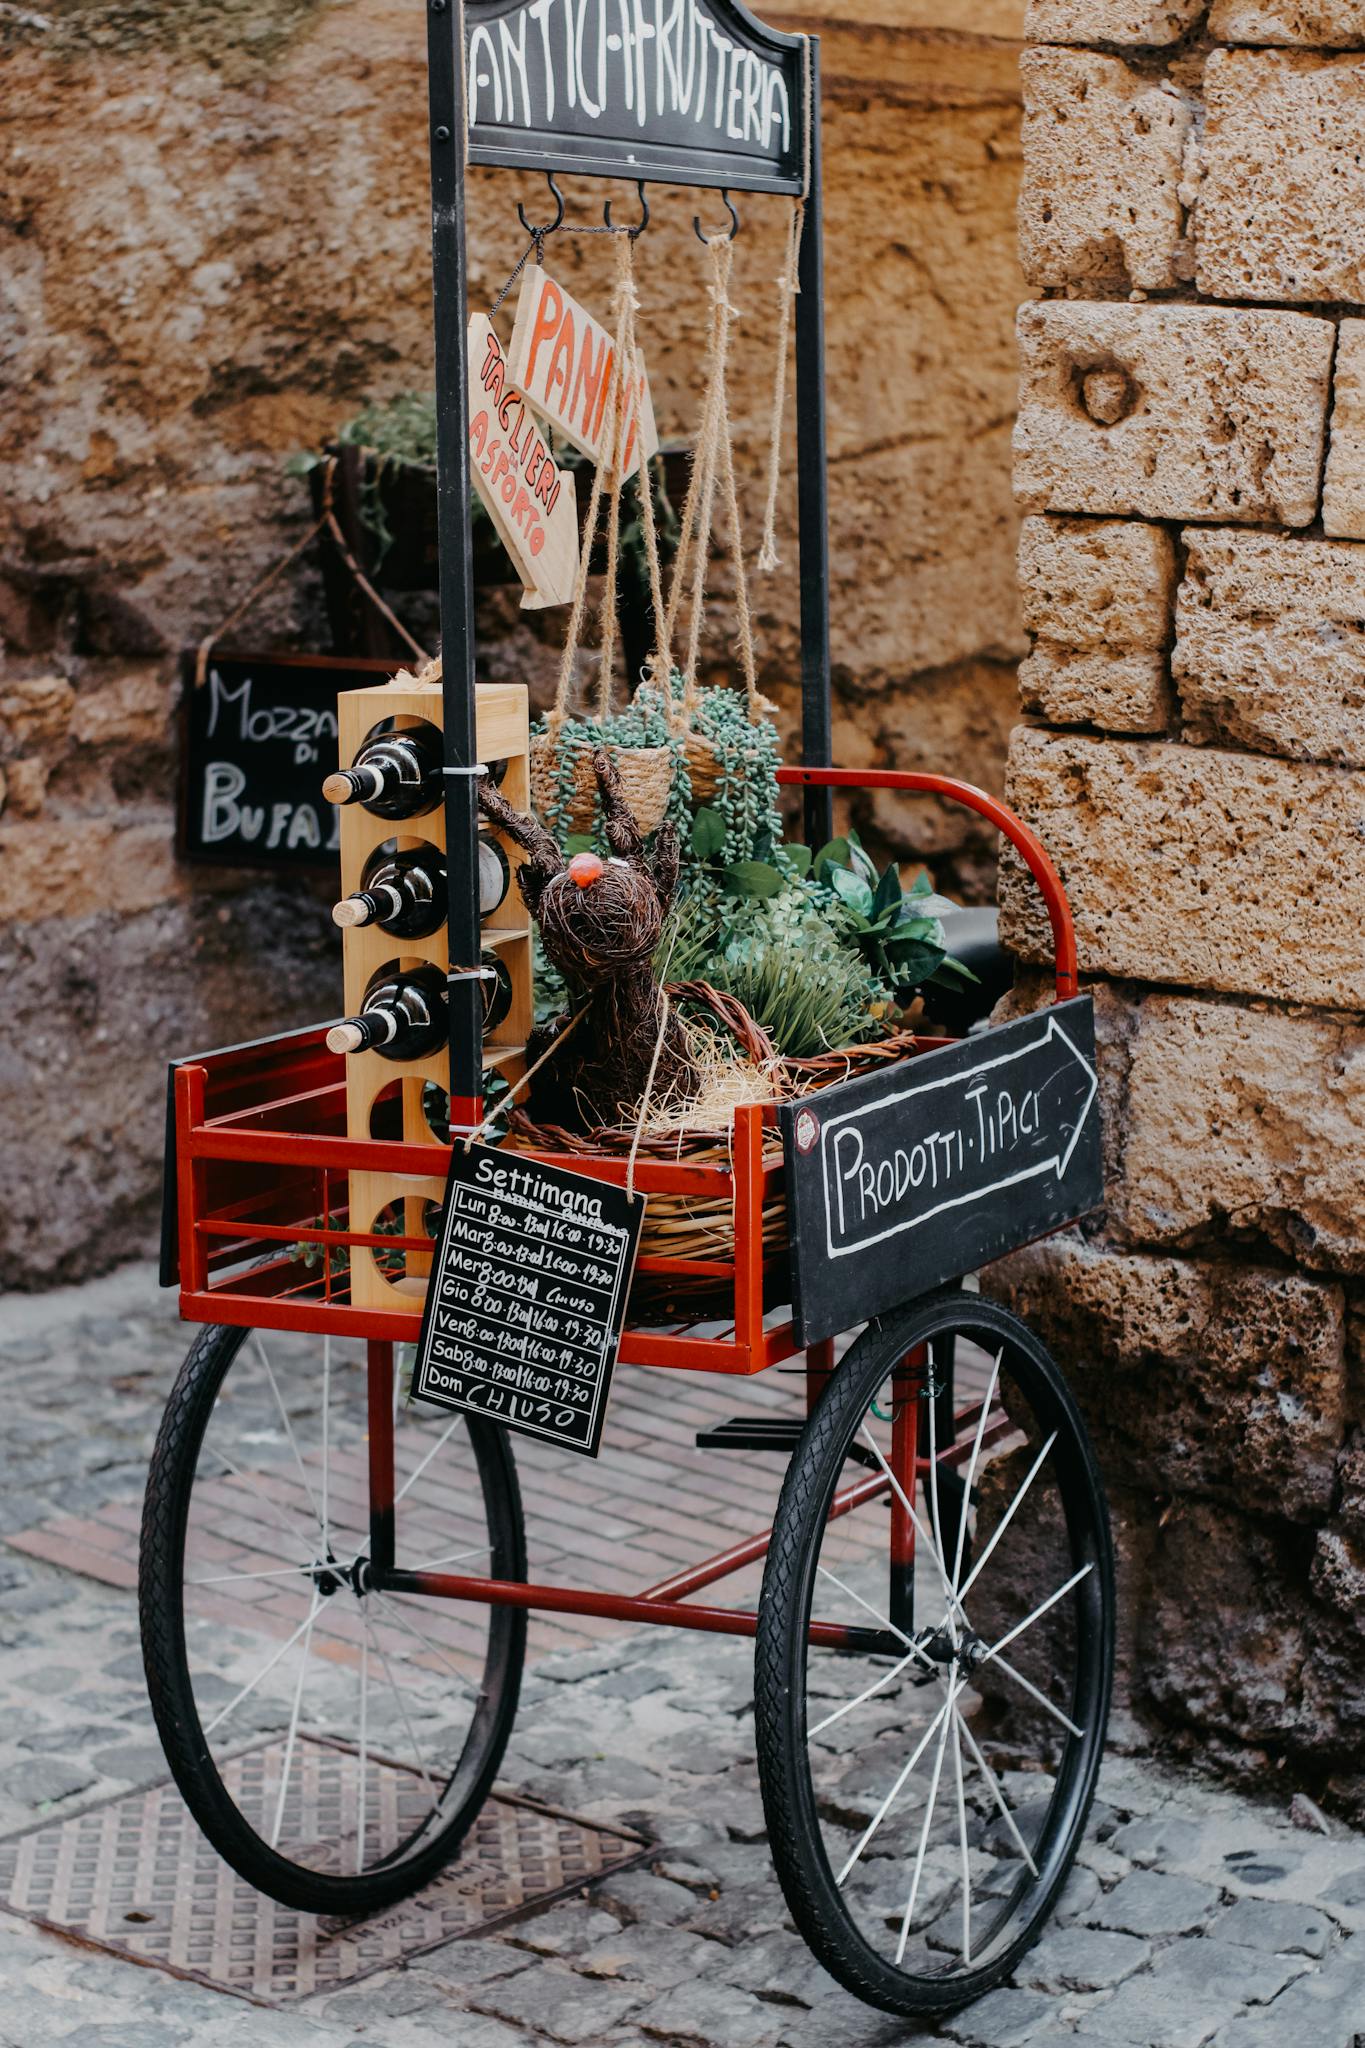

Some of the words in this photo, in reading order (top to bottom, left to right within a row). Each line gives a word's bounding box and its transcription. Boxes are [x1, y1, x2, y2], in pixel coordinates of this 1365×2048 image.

[469, 410, 545, 557] ASPORTO
[475, 1158, 602, 1217] Settimana
[458, 1191, 487, 1215] Lun
[453, 1220, 485, 1244] Mar
[448, 1250, 482, 1273] Mer
[443, 1279, 468, 1300] Gio
[439, 1311, 466, 1335] Ven
[433, 1340, 463, 1362] Sab
[428, 1367, 462, 1393] Dom
[466, 1385, 575, 1426] CHIUSO
